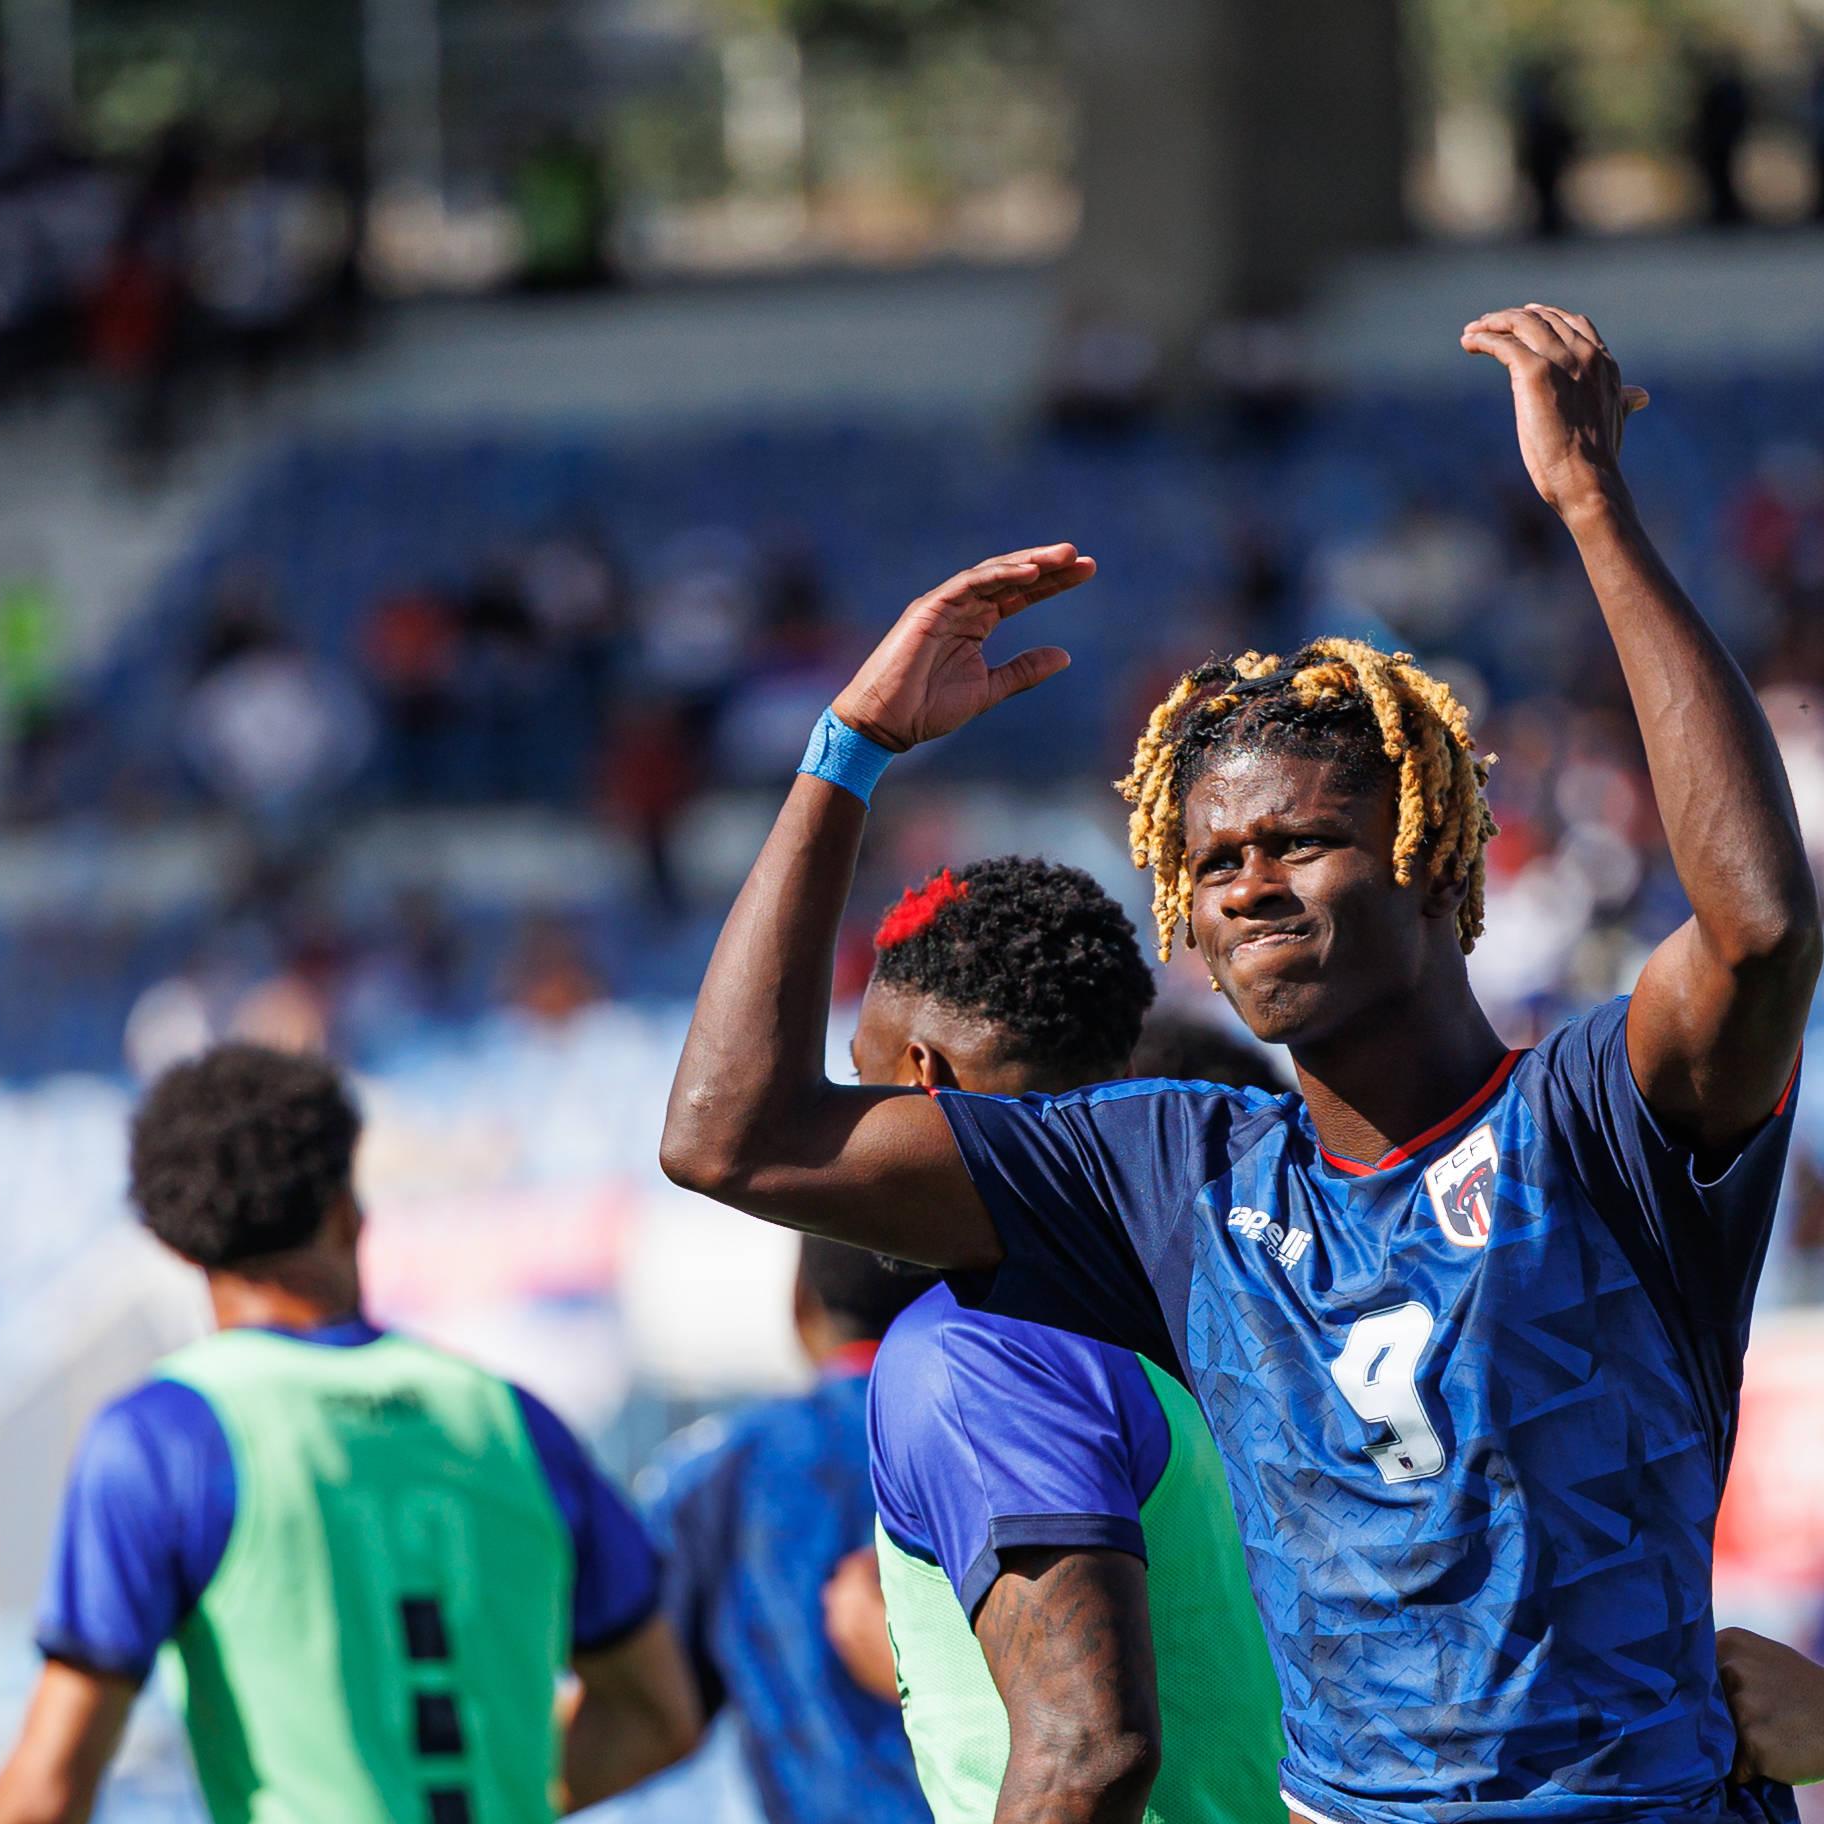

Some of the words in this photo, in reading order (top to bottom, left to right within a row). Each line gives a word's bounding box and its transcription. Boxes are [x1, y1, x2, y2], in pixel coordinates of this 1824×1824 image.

[1433, 1135, 1485, 1185] FCF
[1246, 1228, 1297, 1271] SPORT
[1330, 1300, 1446, 1485] 9
